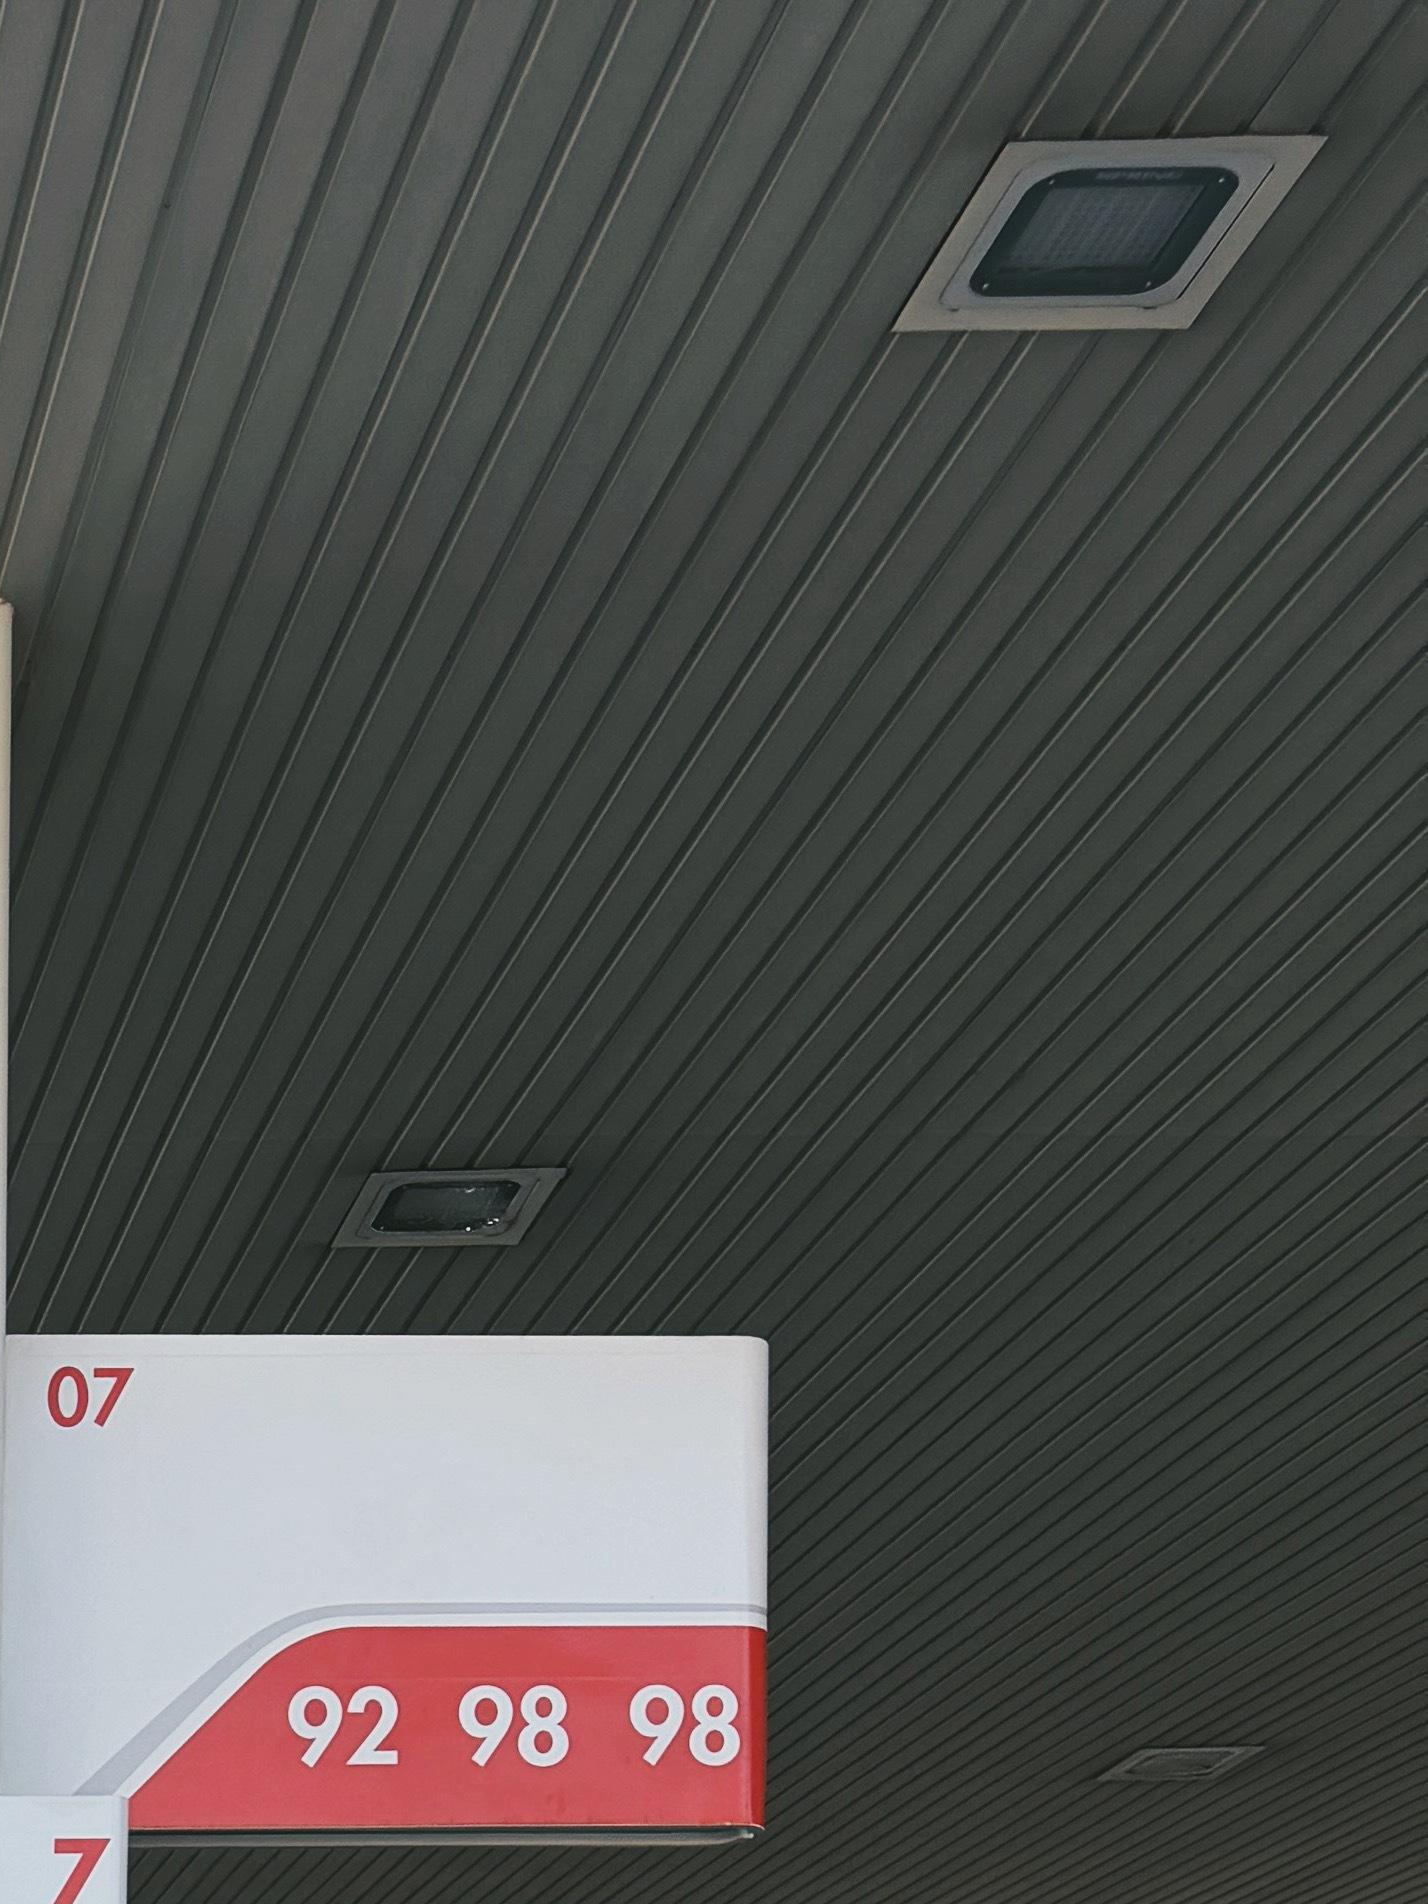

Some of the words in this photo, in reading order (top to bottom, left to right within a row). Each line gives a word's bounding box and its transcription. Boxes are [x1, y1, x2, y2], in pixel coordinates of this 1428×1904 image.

[47, 1366, 134, 1428] 07
[287, 1685, 399, 1768] 92
[458, 1685, 569, 1768] 98
[629, 1685, 741, 1767] 98
